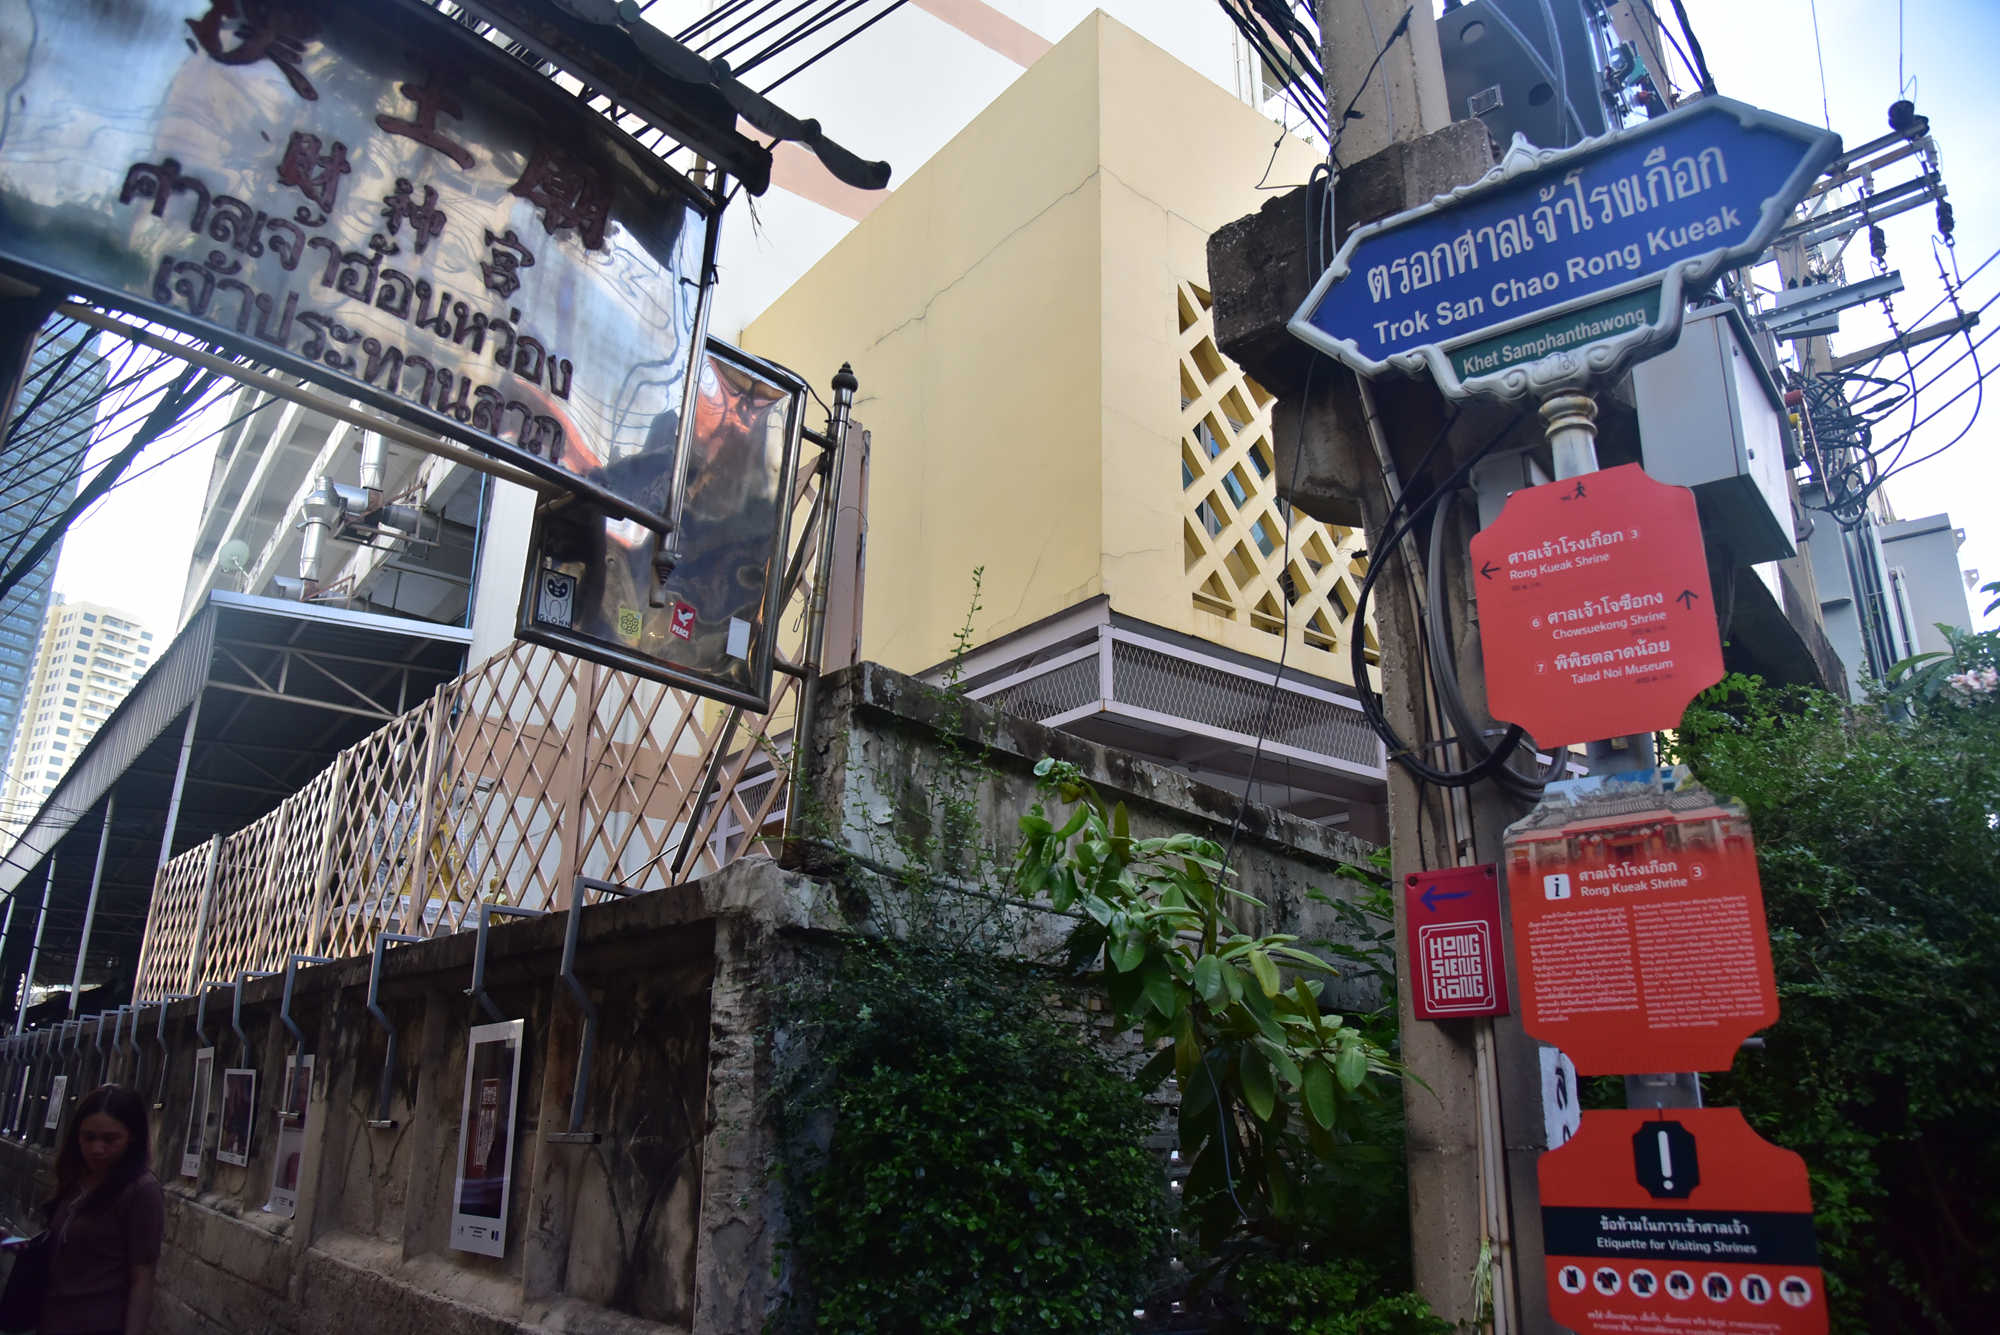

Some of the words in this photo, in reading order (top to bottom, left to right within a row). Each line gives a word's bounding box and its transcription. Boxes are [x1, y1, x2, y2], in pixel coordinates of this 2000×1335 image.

[1366, 146, 1729, 303] ตรอกศาลเจ้าโรงเกือก
[1373, 312, 1430, 345] Trok
[1436, 297, 1485, 327] San
[1490, 270, 1559, 308] Chao
[1566, 243, 1642, 284] Rong
[1647, 205, 1741, 257] Kueak
[1462, 350, 1499, 376] Khet
[1502, 306, 1648, 368] Samphanthawong
[1508, 530, 1624, 565] ศาลเจ้าโรงเกือก
[1631, 529, 1639, 539] 3
[1510, 568, 1537, 580] Rong
[1540, 560, 1573, 575] Kueak
[1575, 552, 1610, 568] Shrine
[538, 613, 572, 629] GLONN
[1532, 618, 1540, 628] 6
[1547, 592, 1664, 625] ศาลเจ้าโจซือกง
[672, 624, 690, 640] PEACE
[1552, 619, 1628, 640] Chowsuekong
[1630, 611, 1666, 626] Shrine
[1537, 663, 1544, 673] 7
[1554, 638, 1671, 671] พิพิธตลาดน้อย
[1571, 670, 1600, 685] Talad
[1602, 667, 1622, 679] Noi
[1625, 660, 1674, 675] Museum
[1579, 860, 1678, 882] ศาลเจ้าโรงเกือก
[1693, 867, 1701, 877] 3
[1580, 885, 1609, 898] Rong
[1612, 880, 1647, 894] Kueak
[1650, 877, 1687, 891] Shrine
[1431, 955, 1481, 978] SIENG
[1596, 1237, 1647, 1251] Etiquette
[1649, 1239, 1666, 1250] for
[1667, 1239, 1711, 1254] Visiting
[1713, 1241, 1758, 1254] Shrines
